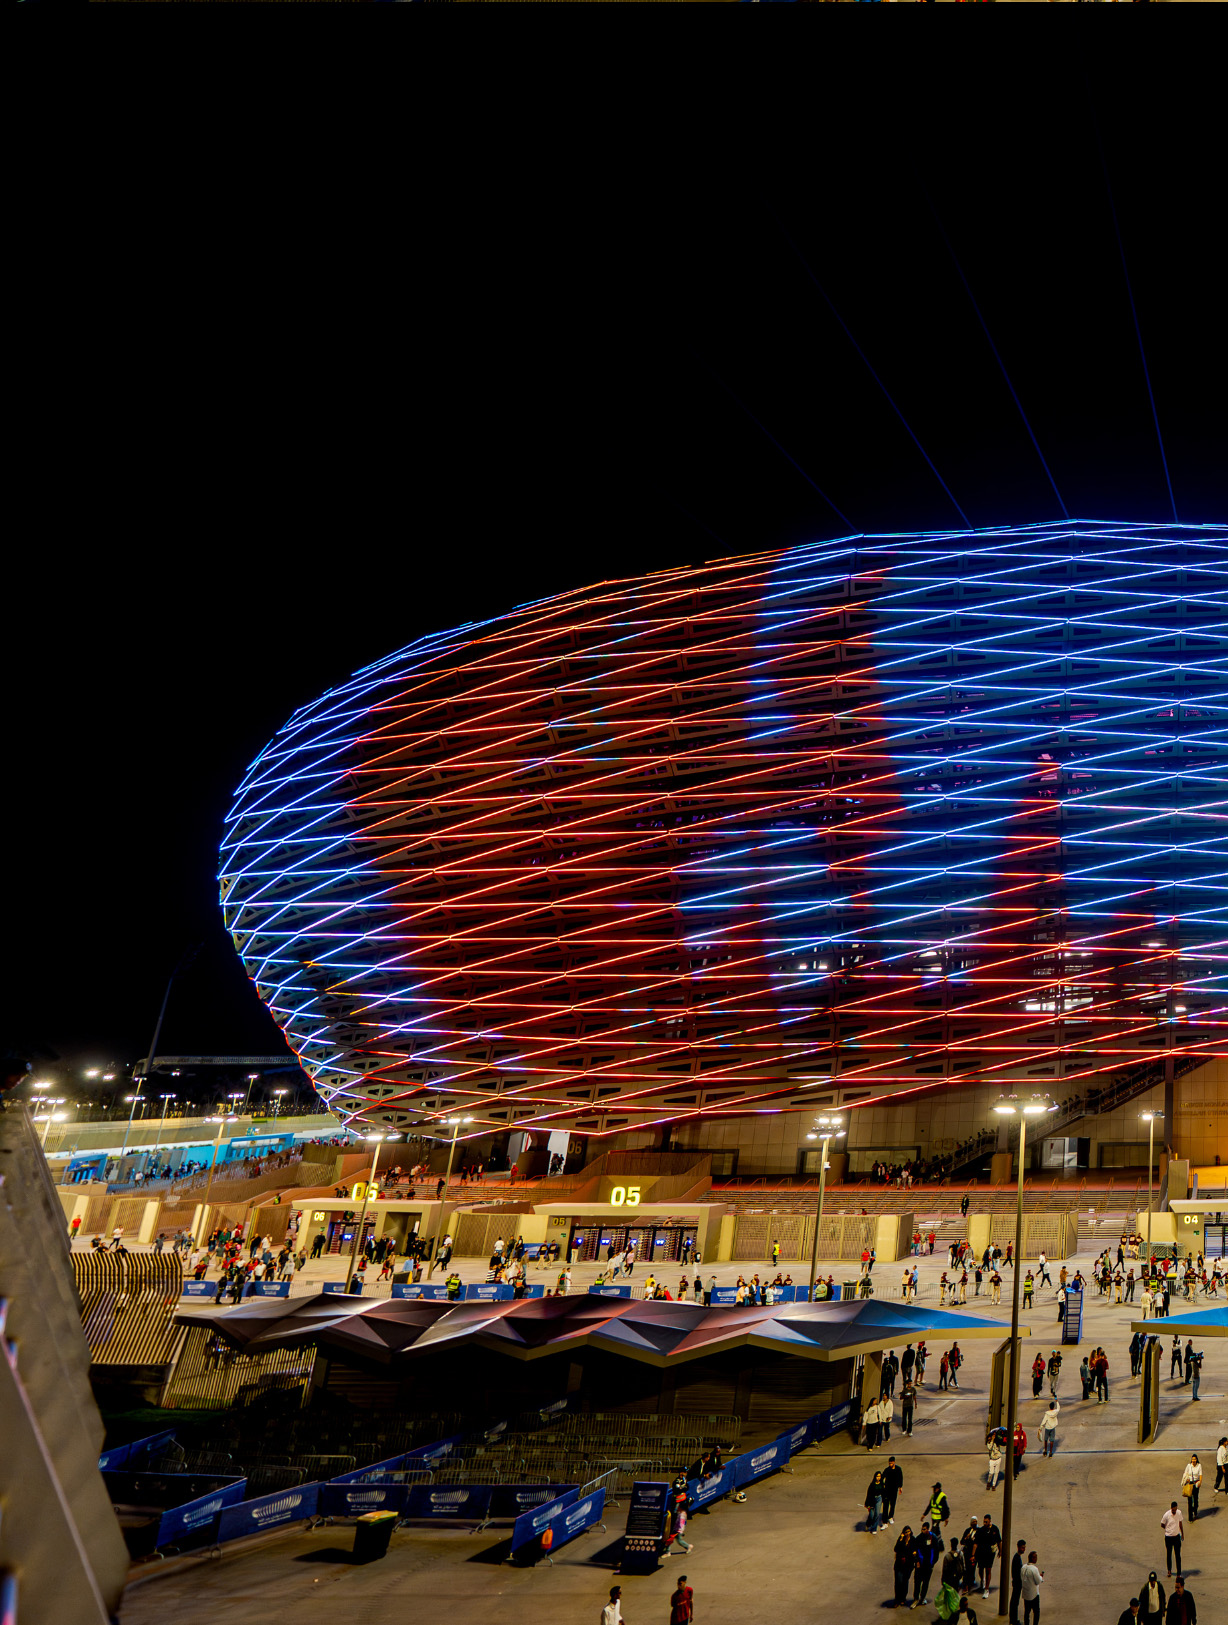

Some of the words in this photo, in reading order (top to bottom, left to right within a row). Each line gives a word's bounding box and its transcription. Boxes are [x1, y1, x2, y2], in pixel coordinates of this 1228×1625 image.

[568, 1140, 582, 1154] 06
[352, 1182, 379, 1203] 06
[610, 1186, 641, 1206] 05
[314, 1212, 325, 1221] 06
[552, 1217, 565, 1226] 05
[1183, 1215, 1199, 1225] 04
